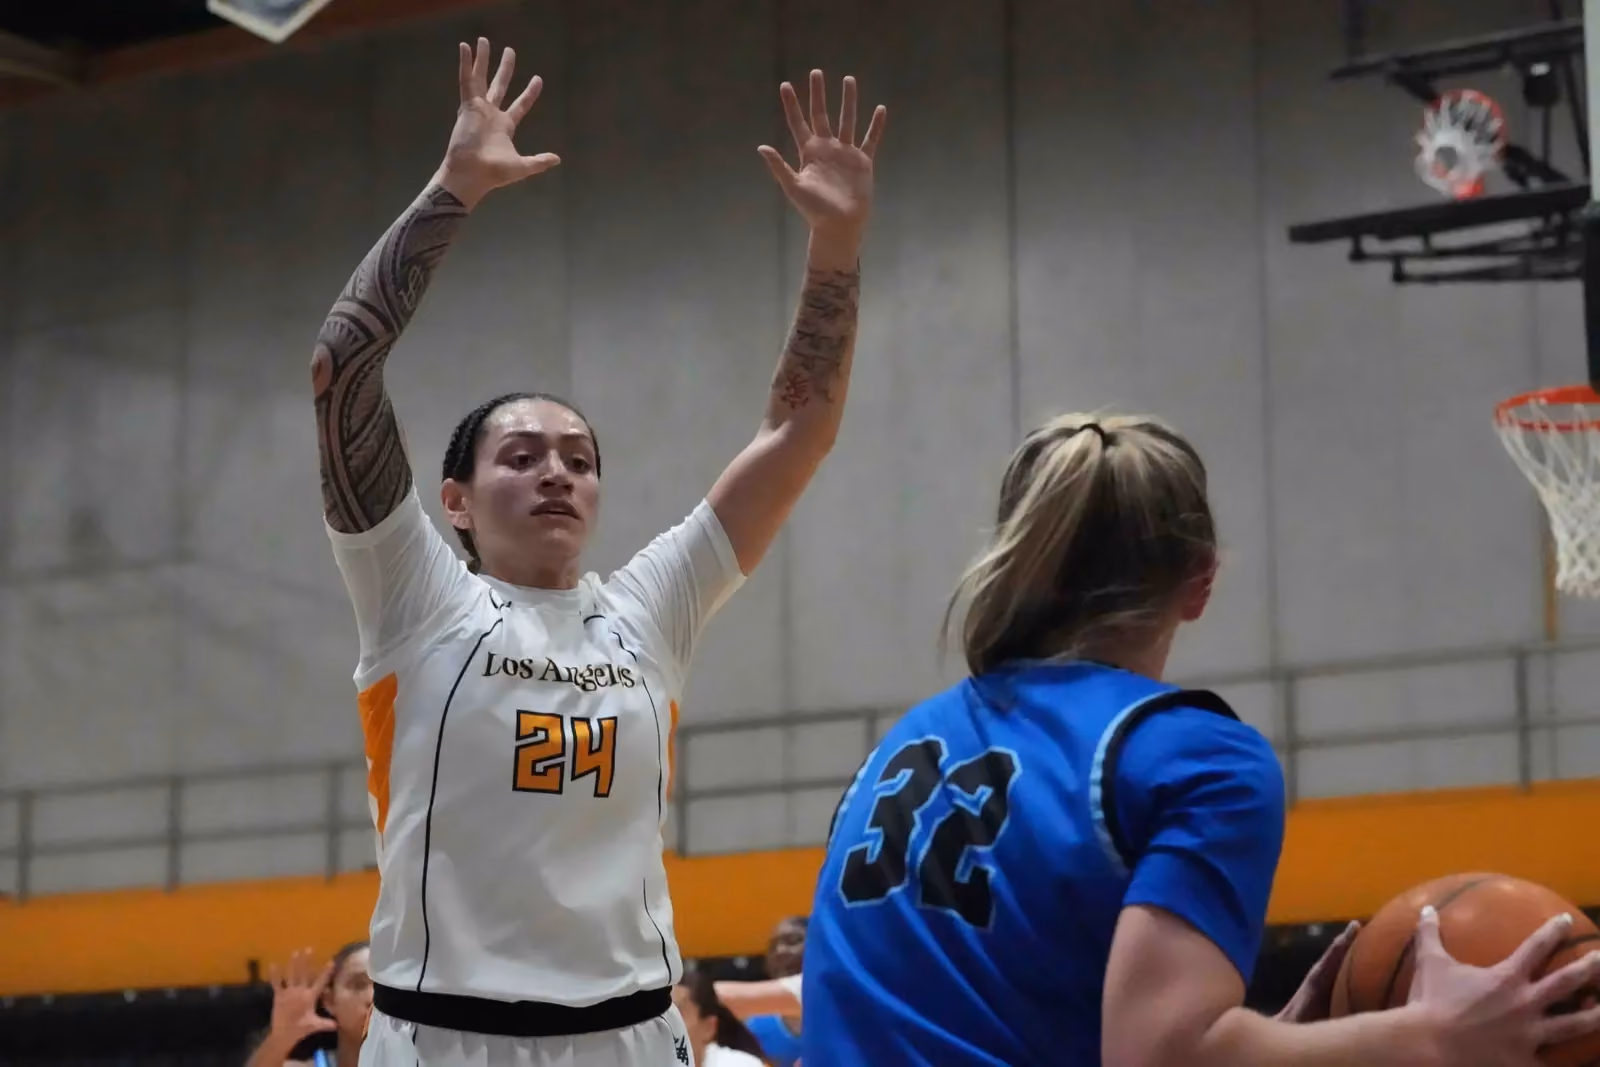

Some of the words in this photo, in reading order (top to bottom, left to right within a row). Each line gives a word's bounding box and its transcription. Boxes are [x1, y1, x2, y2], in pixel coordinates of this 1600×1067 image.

[482, 652, 533, 679] Los
[538, 657, 635, 691] Angels
[512, 709, 617, 798] 24
[839, 735, 1022, 931] 32
